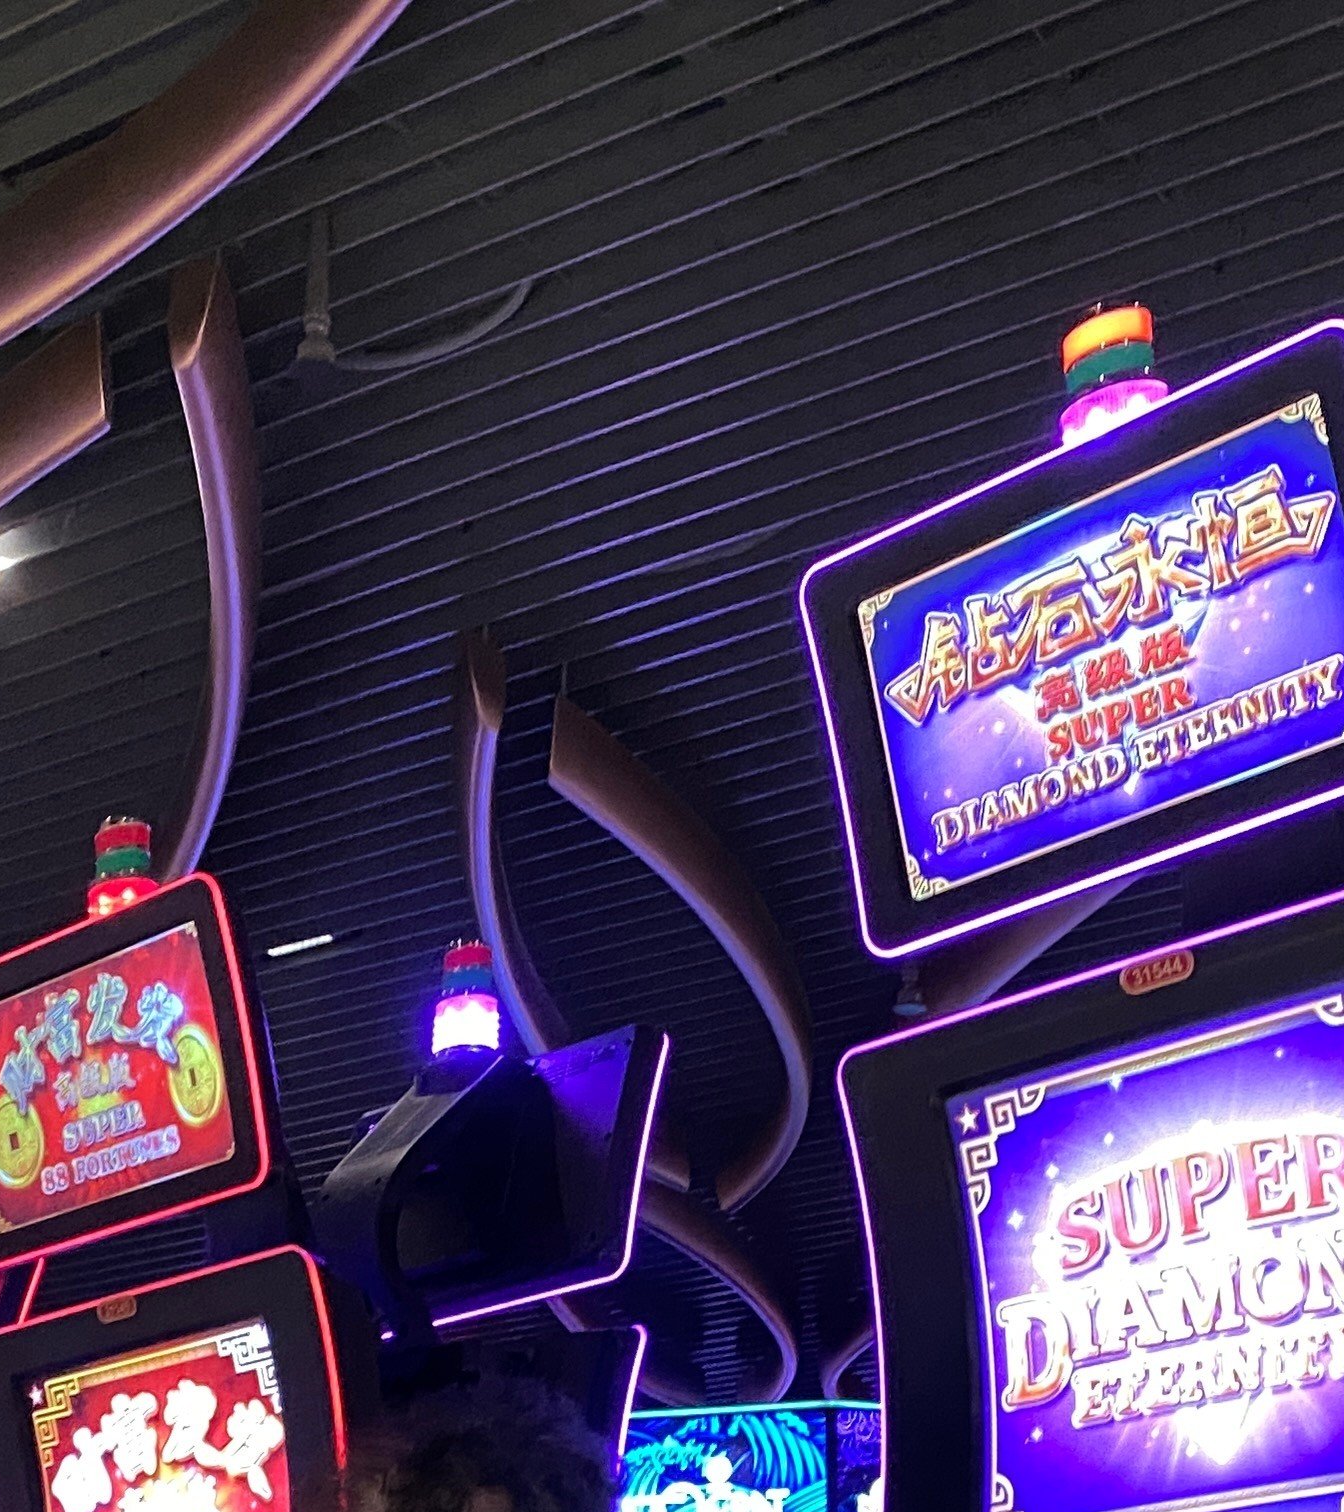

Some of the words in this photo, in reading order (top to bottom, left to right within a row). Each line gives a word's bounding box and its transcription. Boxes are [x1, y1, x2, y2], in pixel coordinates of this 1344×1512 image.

[886, 464, 1336, 727] 钻石永恒
[1035, 624, 1193, 719] 高级版
[931, 744, 1126, 854] DIAMOND
[1134, 654, 1344, 771] ETERNITY
[1047, 675, 1193, 759] SUPER
[40, 1161, 69, 1195] 88
[73, 1125, 181, 1183] FORTUNES
[62, 1100, 146, 1153] SUPER
